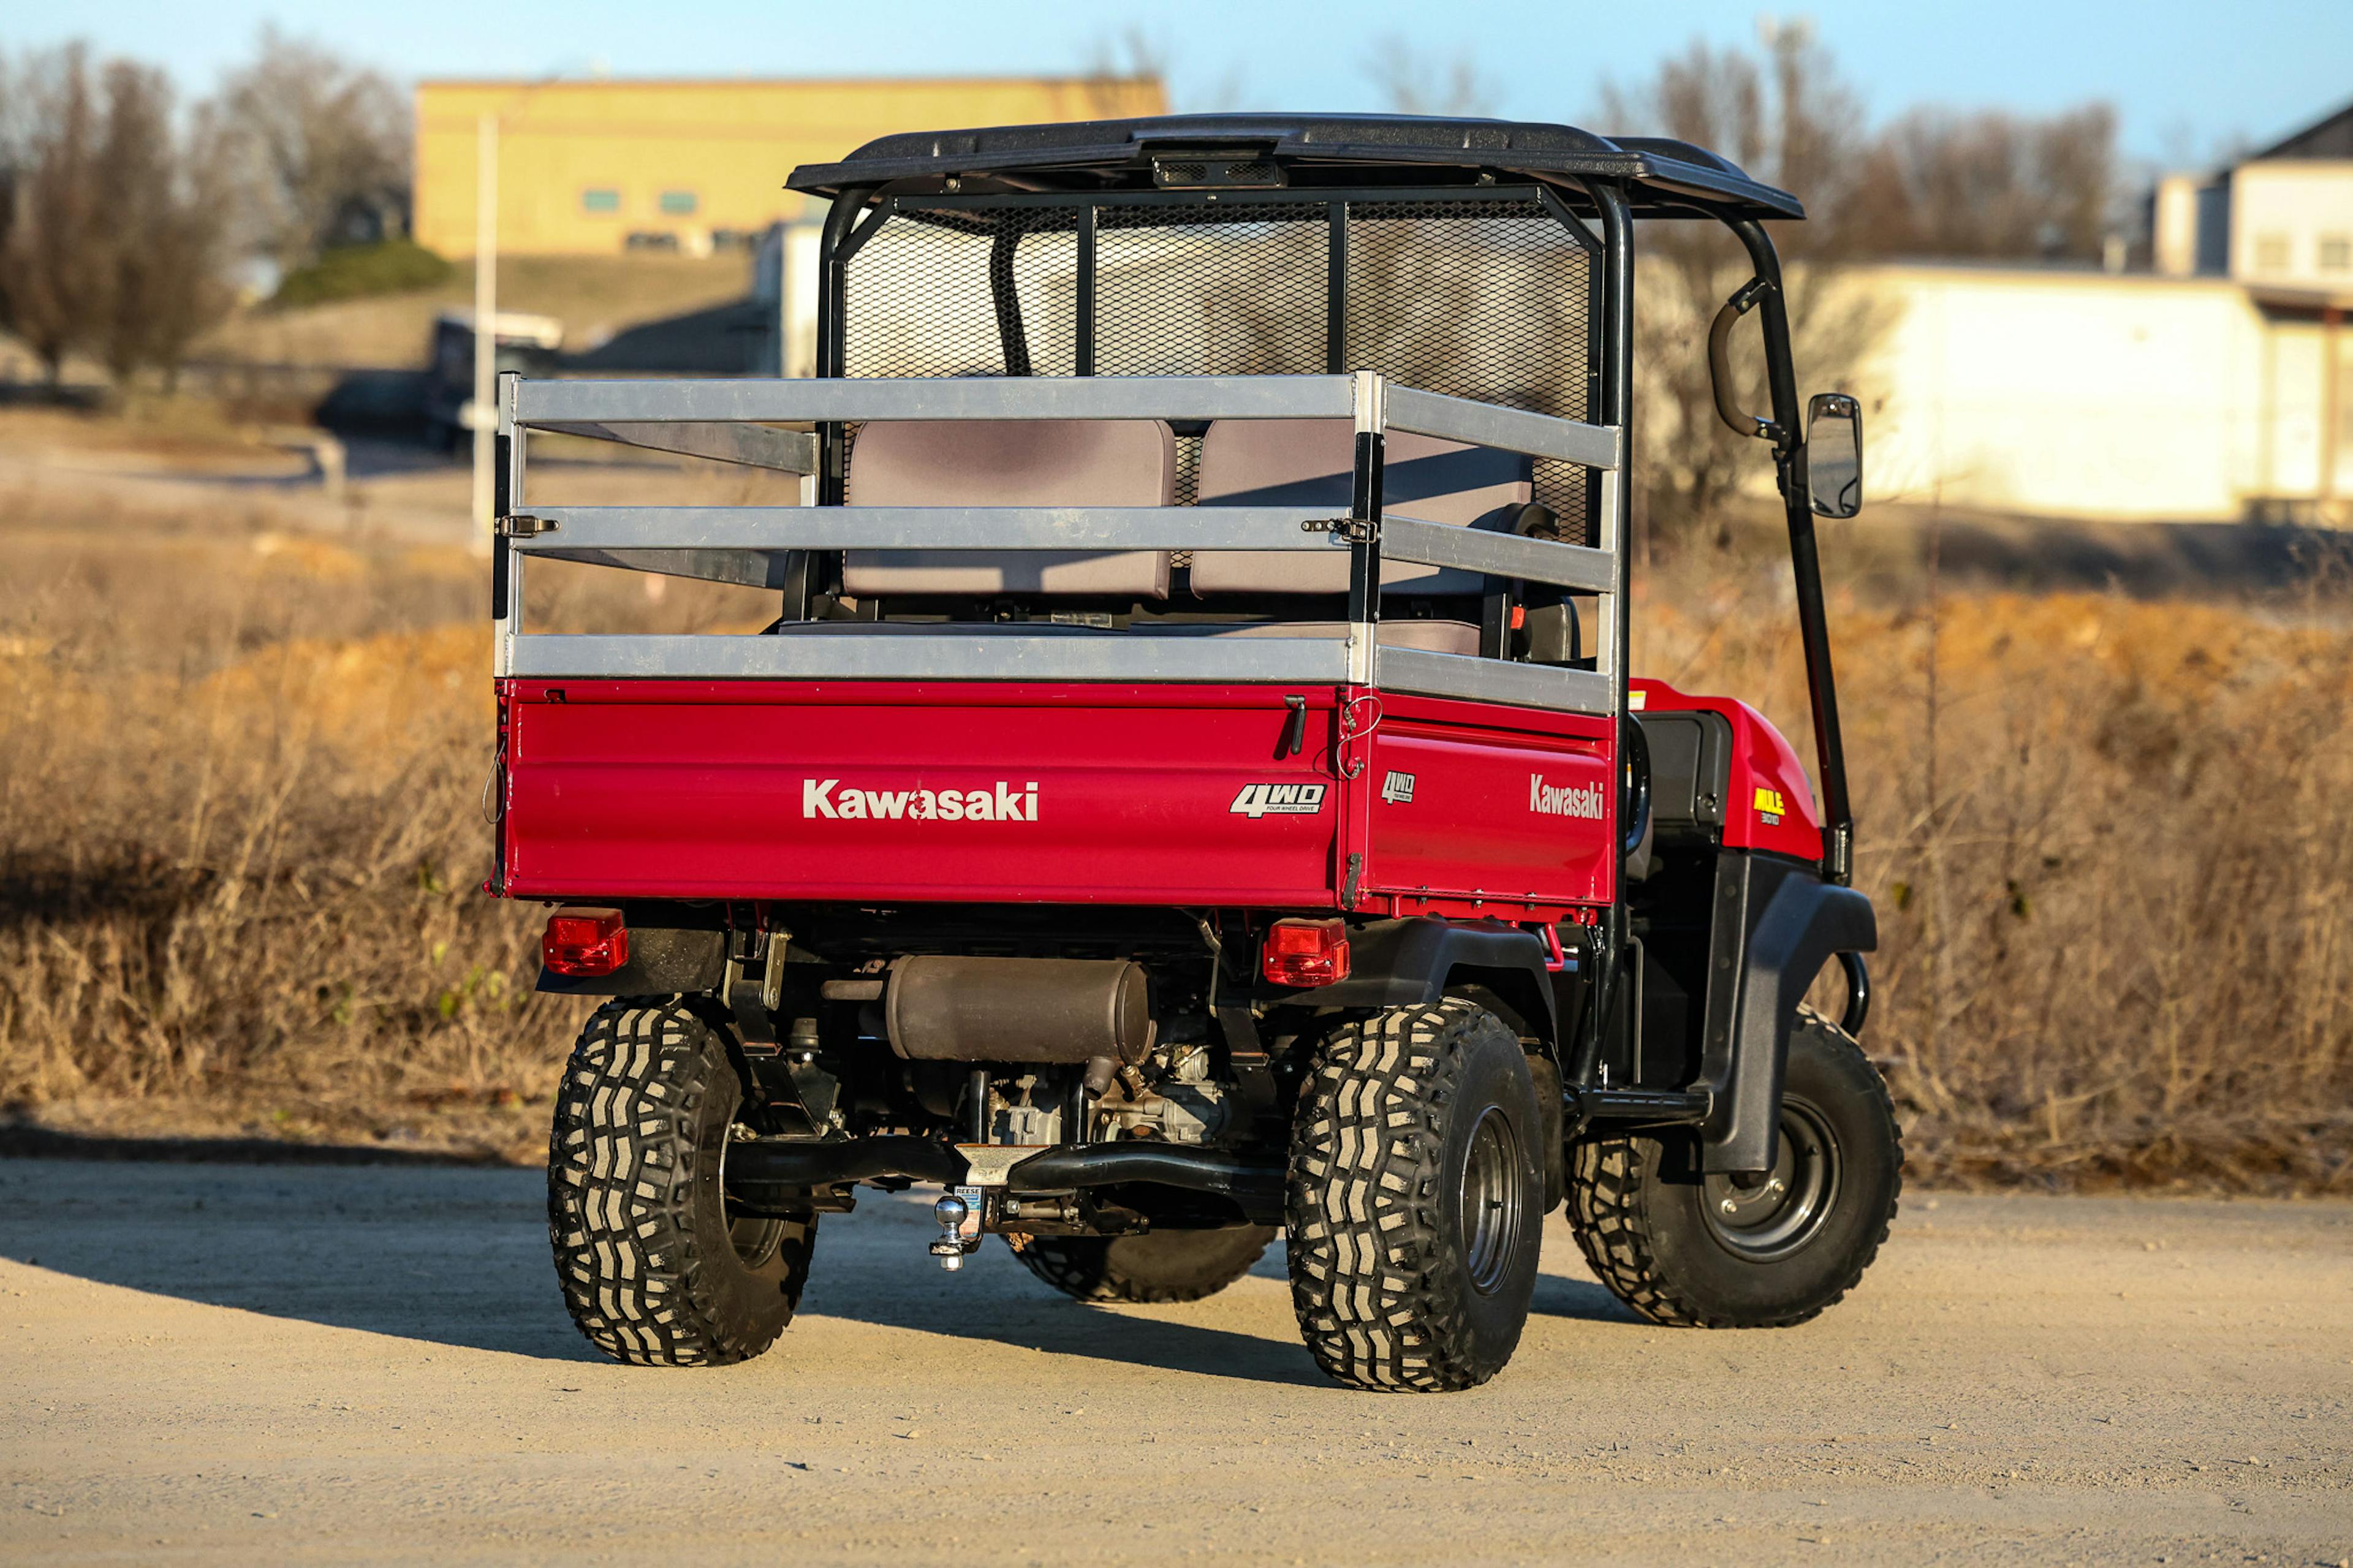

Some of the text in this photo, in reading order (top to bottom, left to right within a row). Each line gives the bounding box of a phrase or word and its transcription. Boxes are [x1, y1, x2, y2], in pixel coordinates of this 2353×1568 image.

[803, 779, 1039, 822] Kawasaki
[1229, 784, 1325, 818] 4WD
[1381, 771, 1415, 804] 4WD
[1529, 773, 1604, 820] Kawasaki
[1753, 787, 1786, 816] MULE
[1761, 812, 1779, 825] 3010
